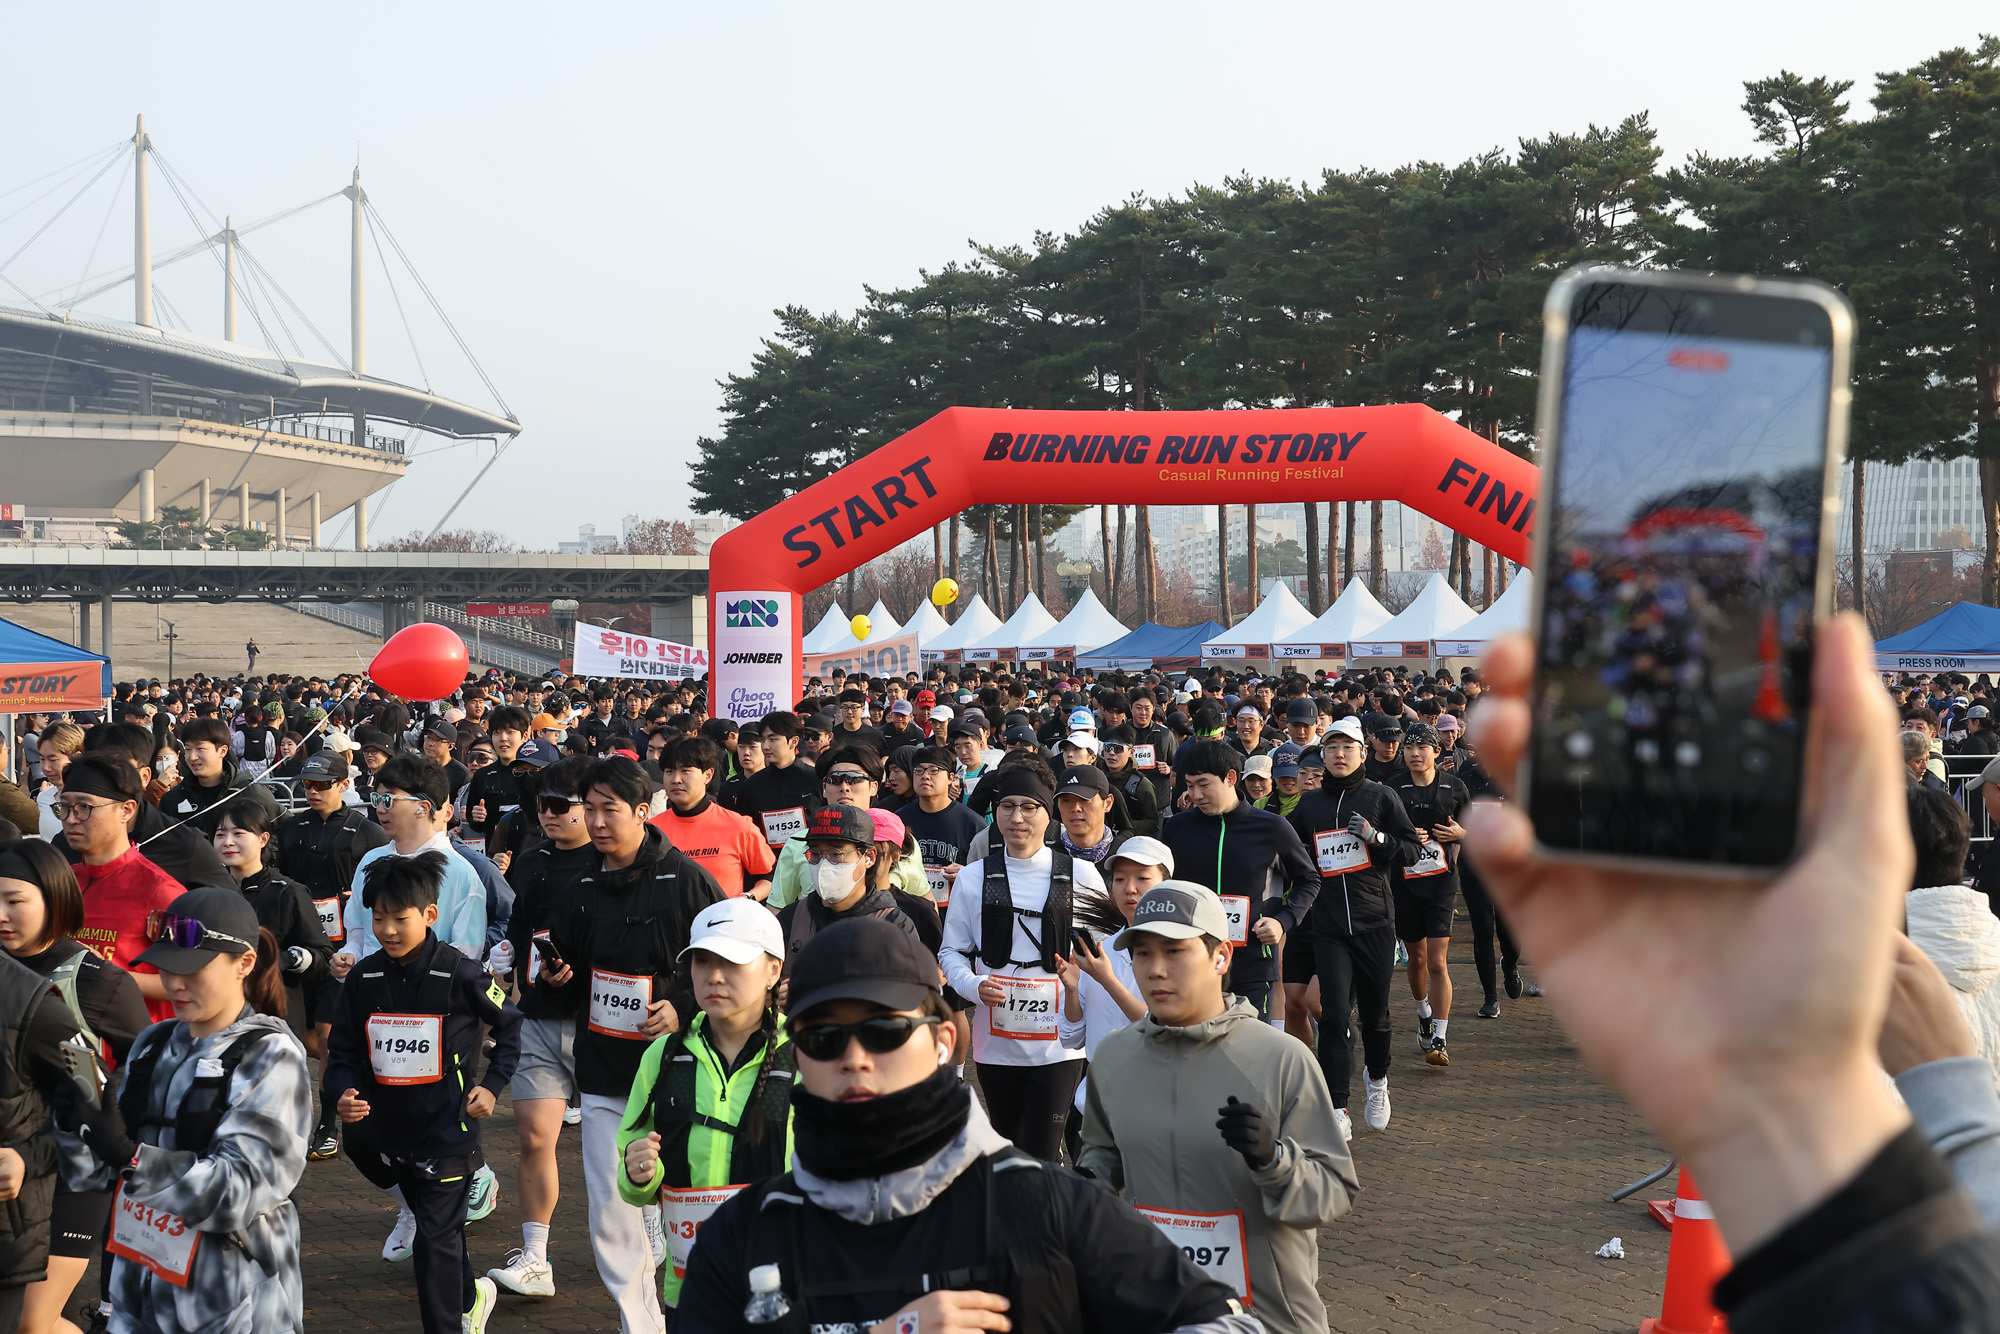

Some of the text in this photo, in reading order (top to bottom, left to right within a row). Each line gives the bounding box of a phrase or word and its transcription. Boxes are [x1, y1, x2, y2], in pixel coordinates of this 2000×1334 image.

[983, 432, 1368, 465] BURNING RUN STORY
[1159, 466, 1344, 482] Casual Running Festival
[1437, 457, 1540, 541] FINI
[782, 455, 938, 569] START
[726, 599, 779, 614] MONO
[726, 614, 779, 628] MANO
[723, 653, 783, 665] JOHNBER
[1898, 658, 1966, 668] PRESS ROOM
[1, 675, 78, 695] STORY
[28, 695, 65, 703] Festival
[731, 688, 775, 702] Choco
[775, 821, 801, 831] 1532
[1322, 841, 1360, 856] M 1474
[1145, 900, 1176, 914] Rab
[602, 993, 642, 1012] 1948
[1008, 998, 1050, 1013] 1723
[1033, 1011, 1055, 1022] A-262
[385, 1039, 430, 1054] 1946
[685, 1195, 701, 1203] RUN
[701, 1193, 729, 1203] STORY
[123, 1198, 134, 1213] W
[134, 1203, 185, 1237] 3143
[1172, 1218, 1190, 1227] RUN
[1190, 1220, 1219, 1229] STORY
[669, 1221, 678, 1235] W
[671, 1255, 685, 1265] 10km
